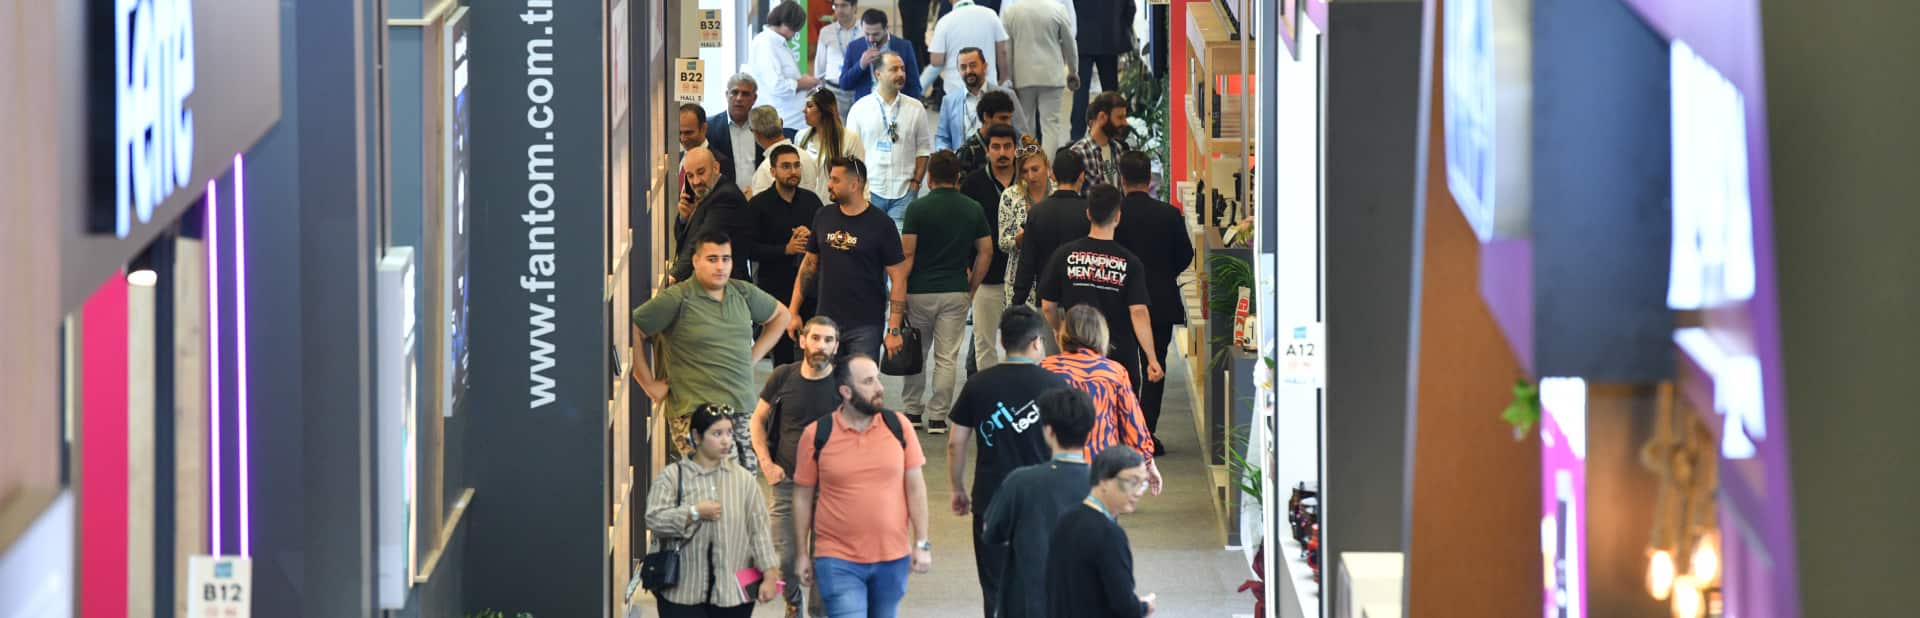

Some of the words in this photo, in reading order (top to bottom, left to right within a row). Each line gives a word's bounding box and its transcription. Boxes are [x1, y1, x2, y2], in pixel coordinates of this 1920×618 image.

[700, 21, 721, 30] B32
[680, 72, 703, 82] B22
[1066, 253, 1127, 272] CHAMPION
[1286, 343, 1315, 356] A12
[203, 582, 243, 602] B12
